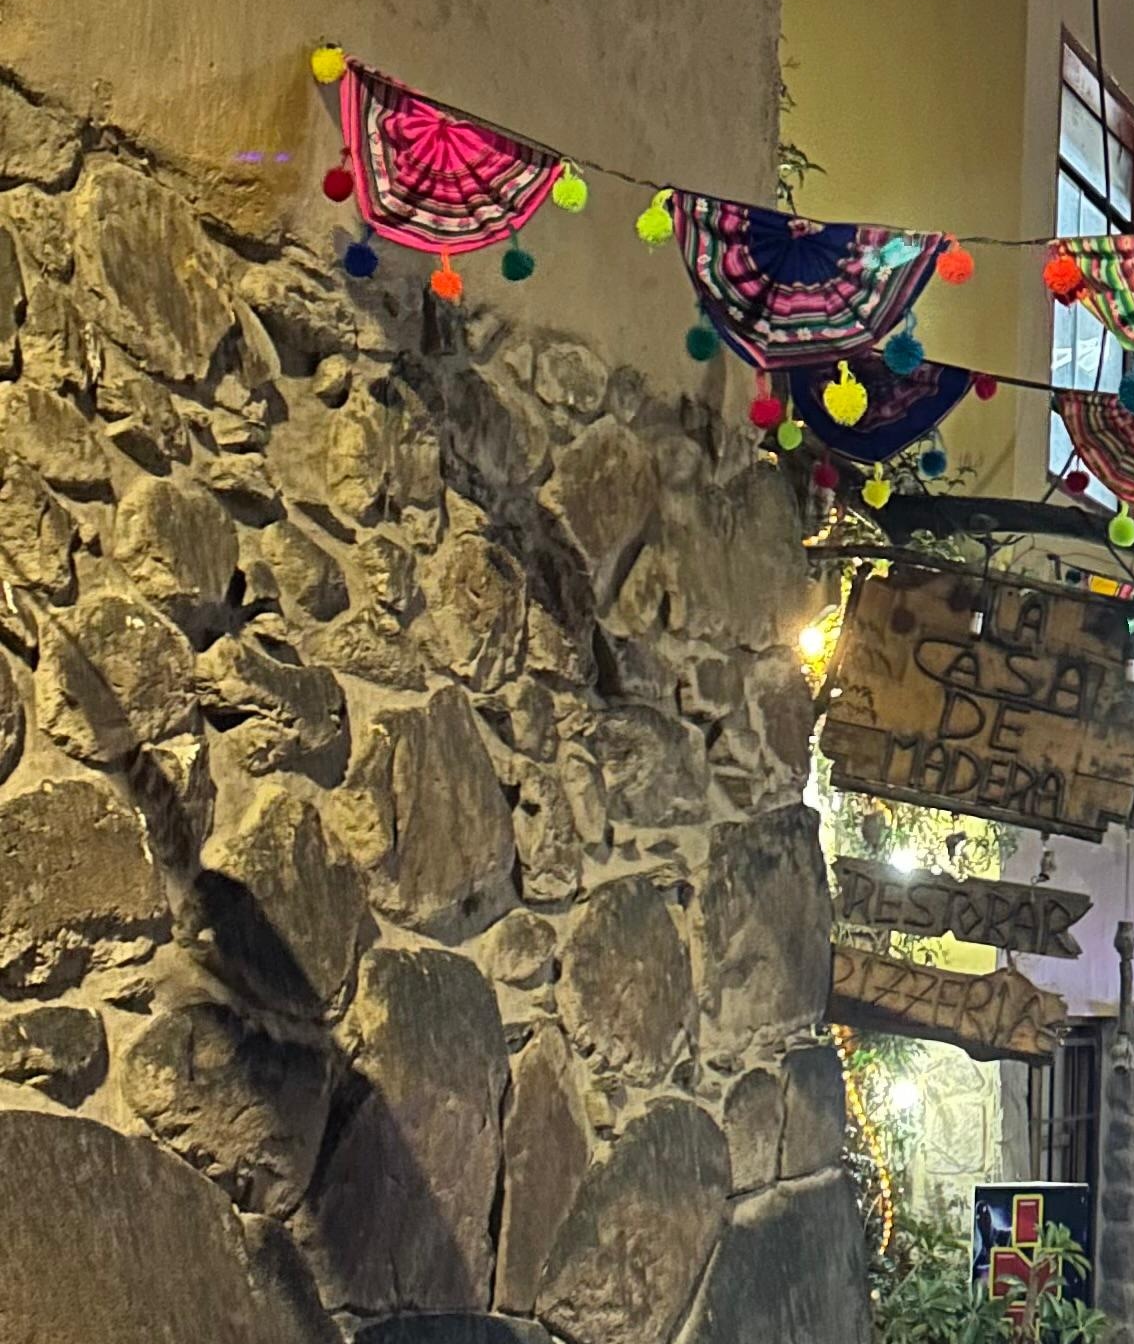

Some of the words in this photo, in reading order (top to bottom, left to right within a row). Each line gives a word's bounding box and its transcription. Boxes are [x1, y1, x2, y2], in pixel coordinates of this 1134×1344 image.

[982, 581, 1046, 653] LA
[913, 639, 1088, 719] CASA
[937, 688, 1032, 753] DE
[880, 730, 1066, 817] MADERA
[841, 867, 1078, 956] RESTOBAR
